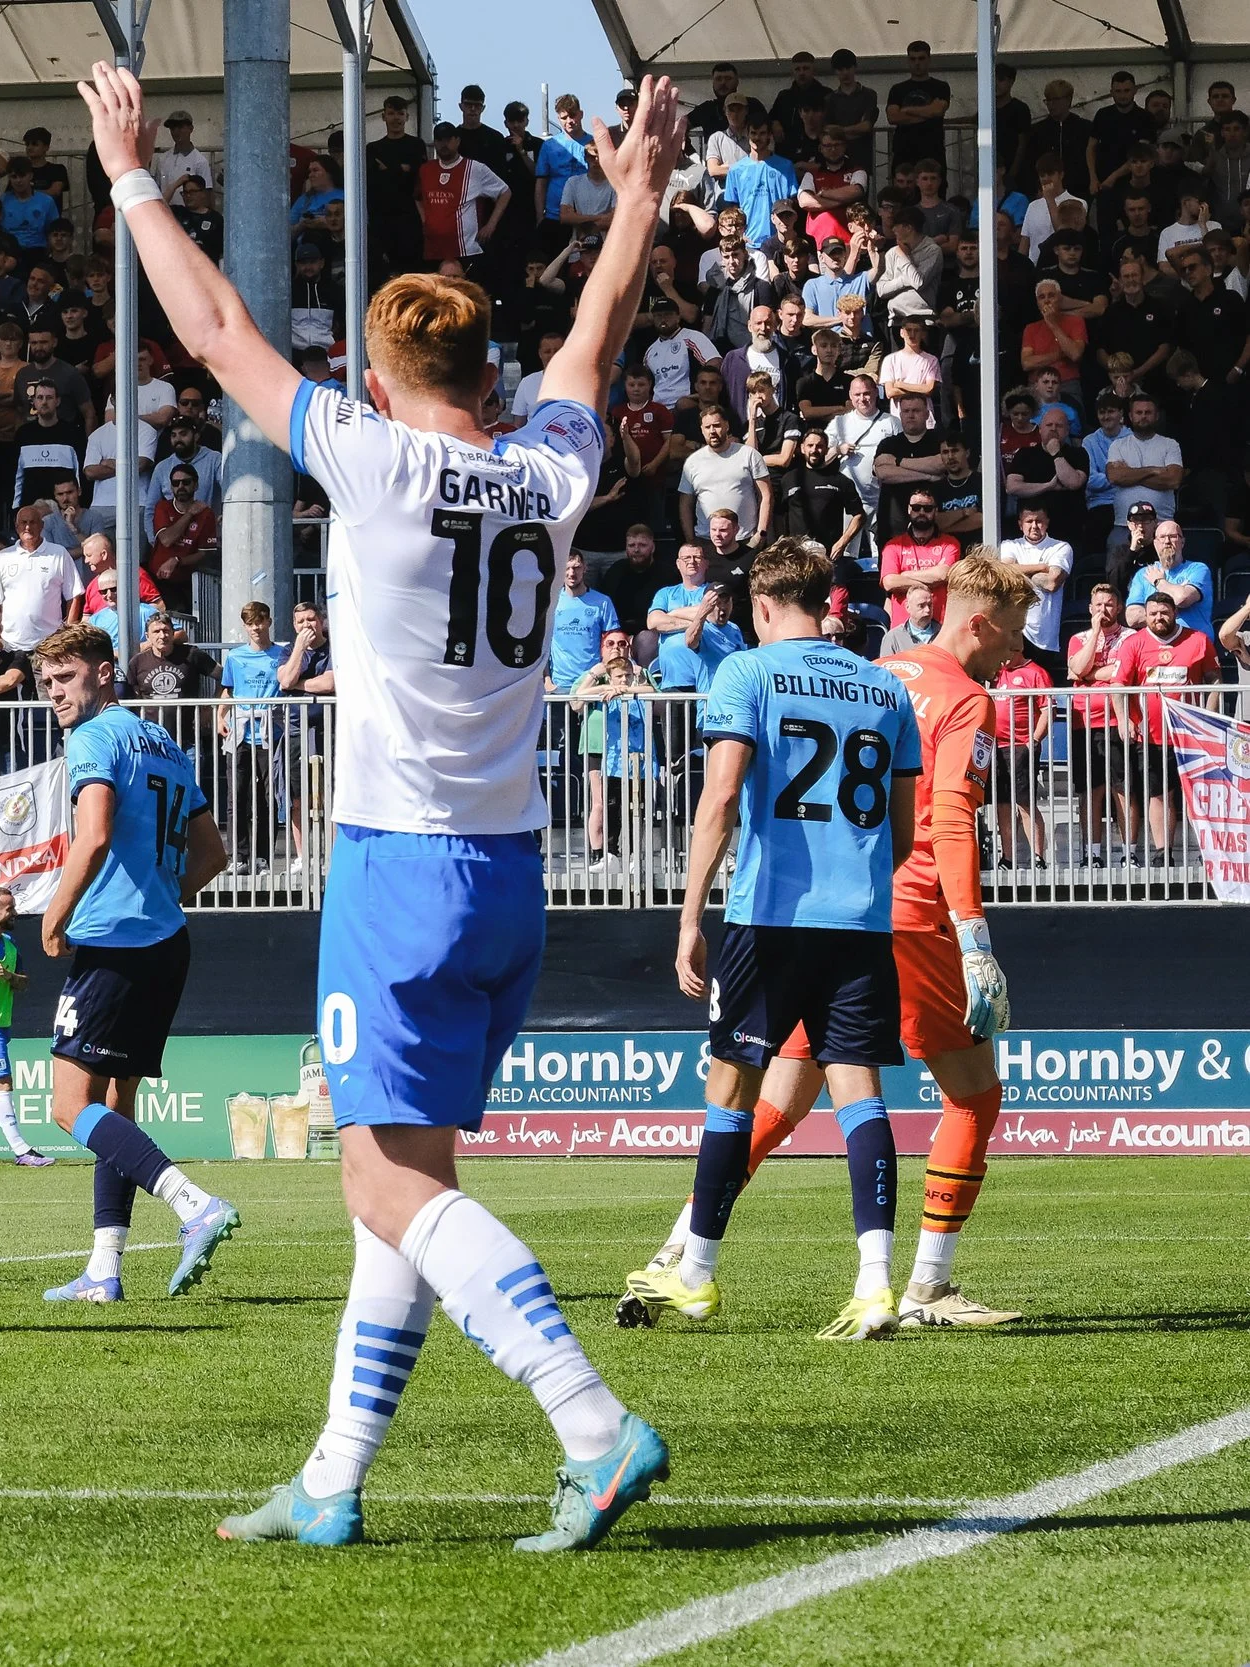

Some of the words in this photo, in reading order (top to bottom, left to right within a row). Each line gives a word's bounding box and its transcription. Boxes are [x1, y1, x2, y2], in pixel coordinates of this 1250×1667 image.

[440, 467, 559, 521] GARNER
[906, 558, 936, 567] BODON
[431, 508, 555, 669] 10
[774, 673, 898, 712] BILLINGTON
[774, 717, 891, 830] 28
[1192, 781, 1250, 821] CRE
[147, 773, 190, 877] 14
[1211, 829, 1248, 853] WAS
[321, 991, 359, 1065] 0
[302, 1067, 327, 1082] JAME
[502, 1039, 683, 1093] Hornby
[997, 1038, 1185, 1092] Hornby
[1198, 1038, 1232, 1081] &
[138, 1092, 205, 1123] IME
[528, 1086, 652, 1103] ACCOUNTANTS
[1025, 1085, 1152, 1102] ACCOUNTANTS
[507, 1117, 562, 1147] than
[570, 1122, 608, 1152] just
[1005, 1115, 1059, 1147] than
[1065, 1120, 1108, 1152] just
[1108, 1117, 1250, 1148] Accounta
[925, 1190, 954, 1203] AFC
